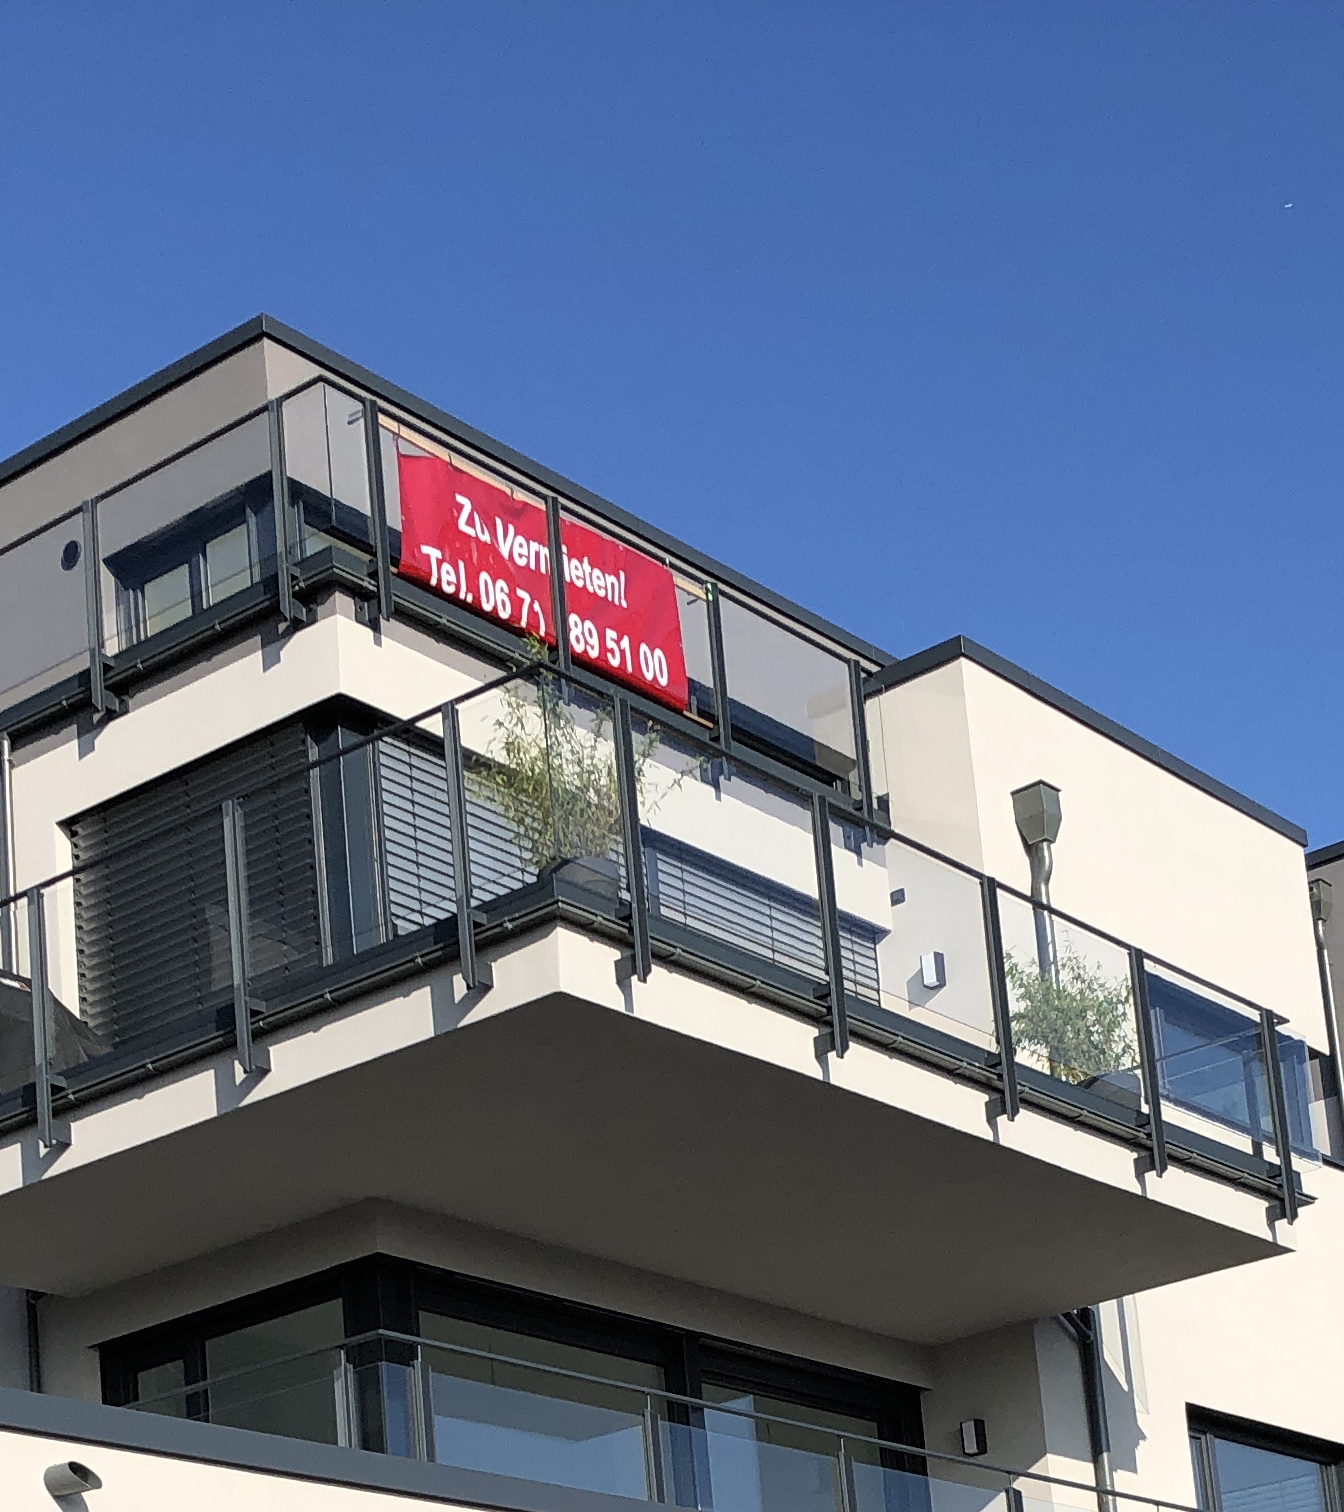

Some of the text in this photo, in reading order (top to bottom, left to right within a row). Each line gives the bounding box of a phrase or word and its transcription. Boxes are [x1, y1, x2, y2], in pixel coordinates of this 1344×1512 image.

[455, 492, 491, 545] Zu
[420, 544, 473, 604] Tel.
[605, 627, 633, 674] 51
[639, 642, 669, 687] 00
